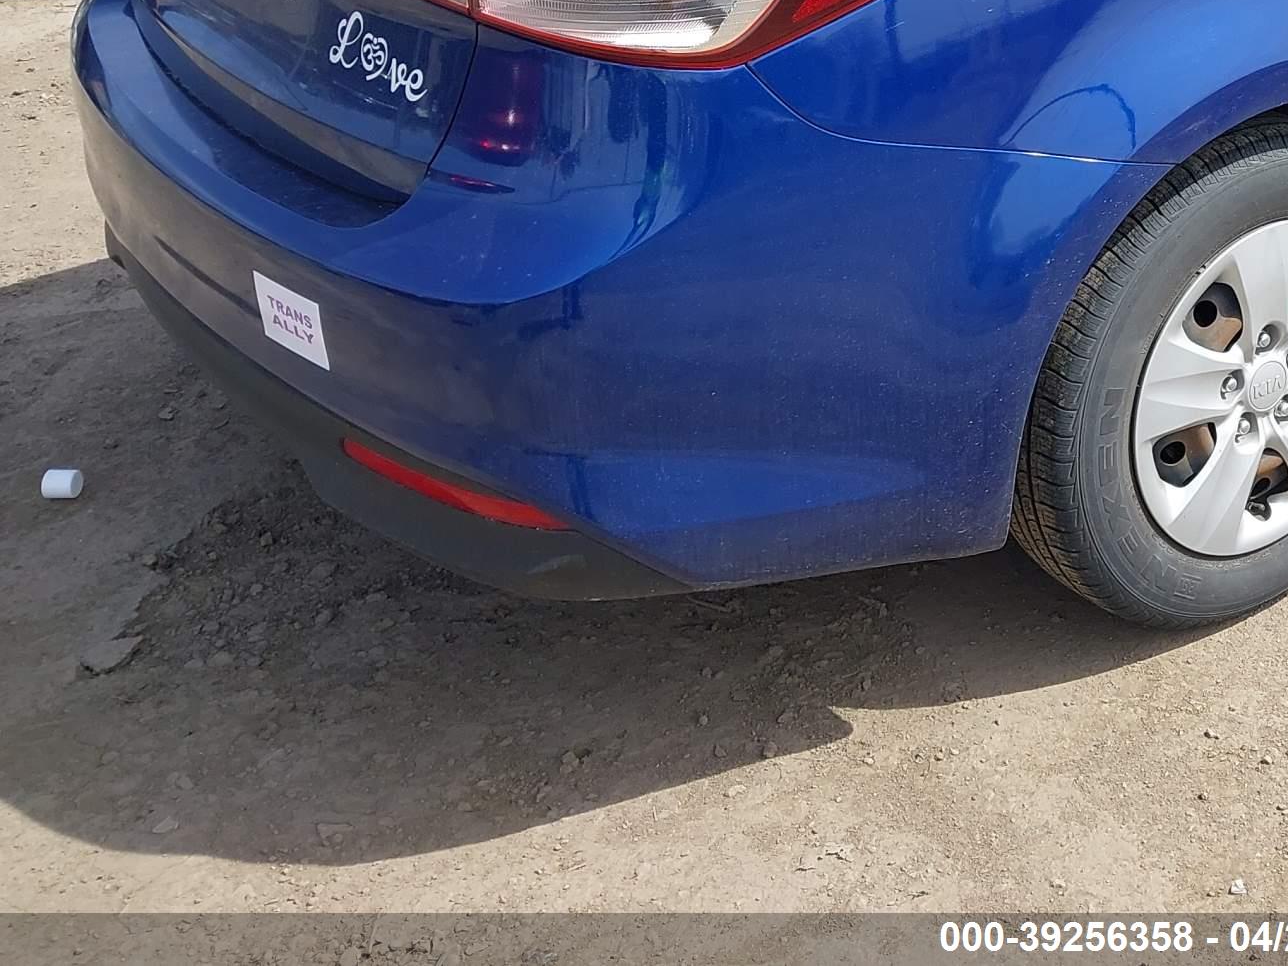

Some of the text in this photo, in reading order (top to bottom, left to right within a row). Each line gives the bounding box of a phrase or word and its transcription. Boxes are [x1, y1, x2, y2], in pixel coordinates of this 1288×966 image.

[267, 294, 313, 329] TRANS
[272, 314, 315, 344] ALLY
[1252, 374, 1282, 400] KIA
